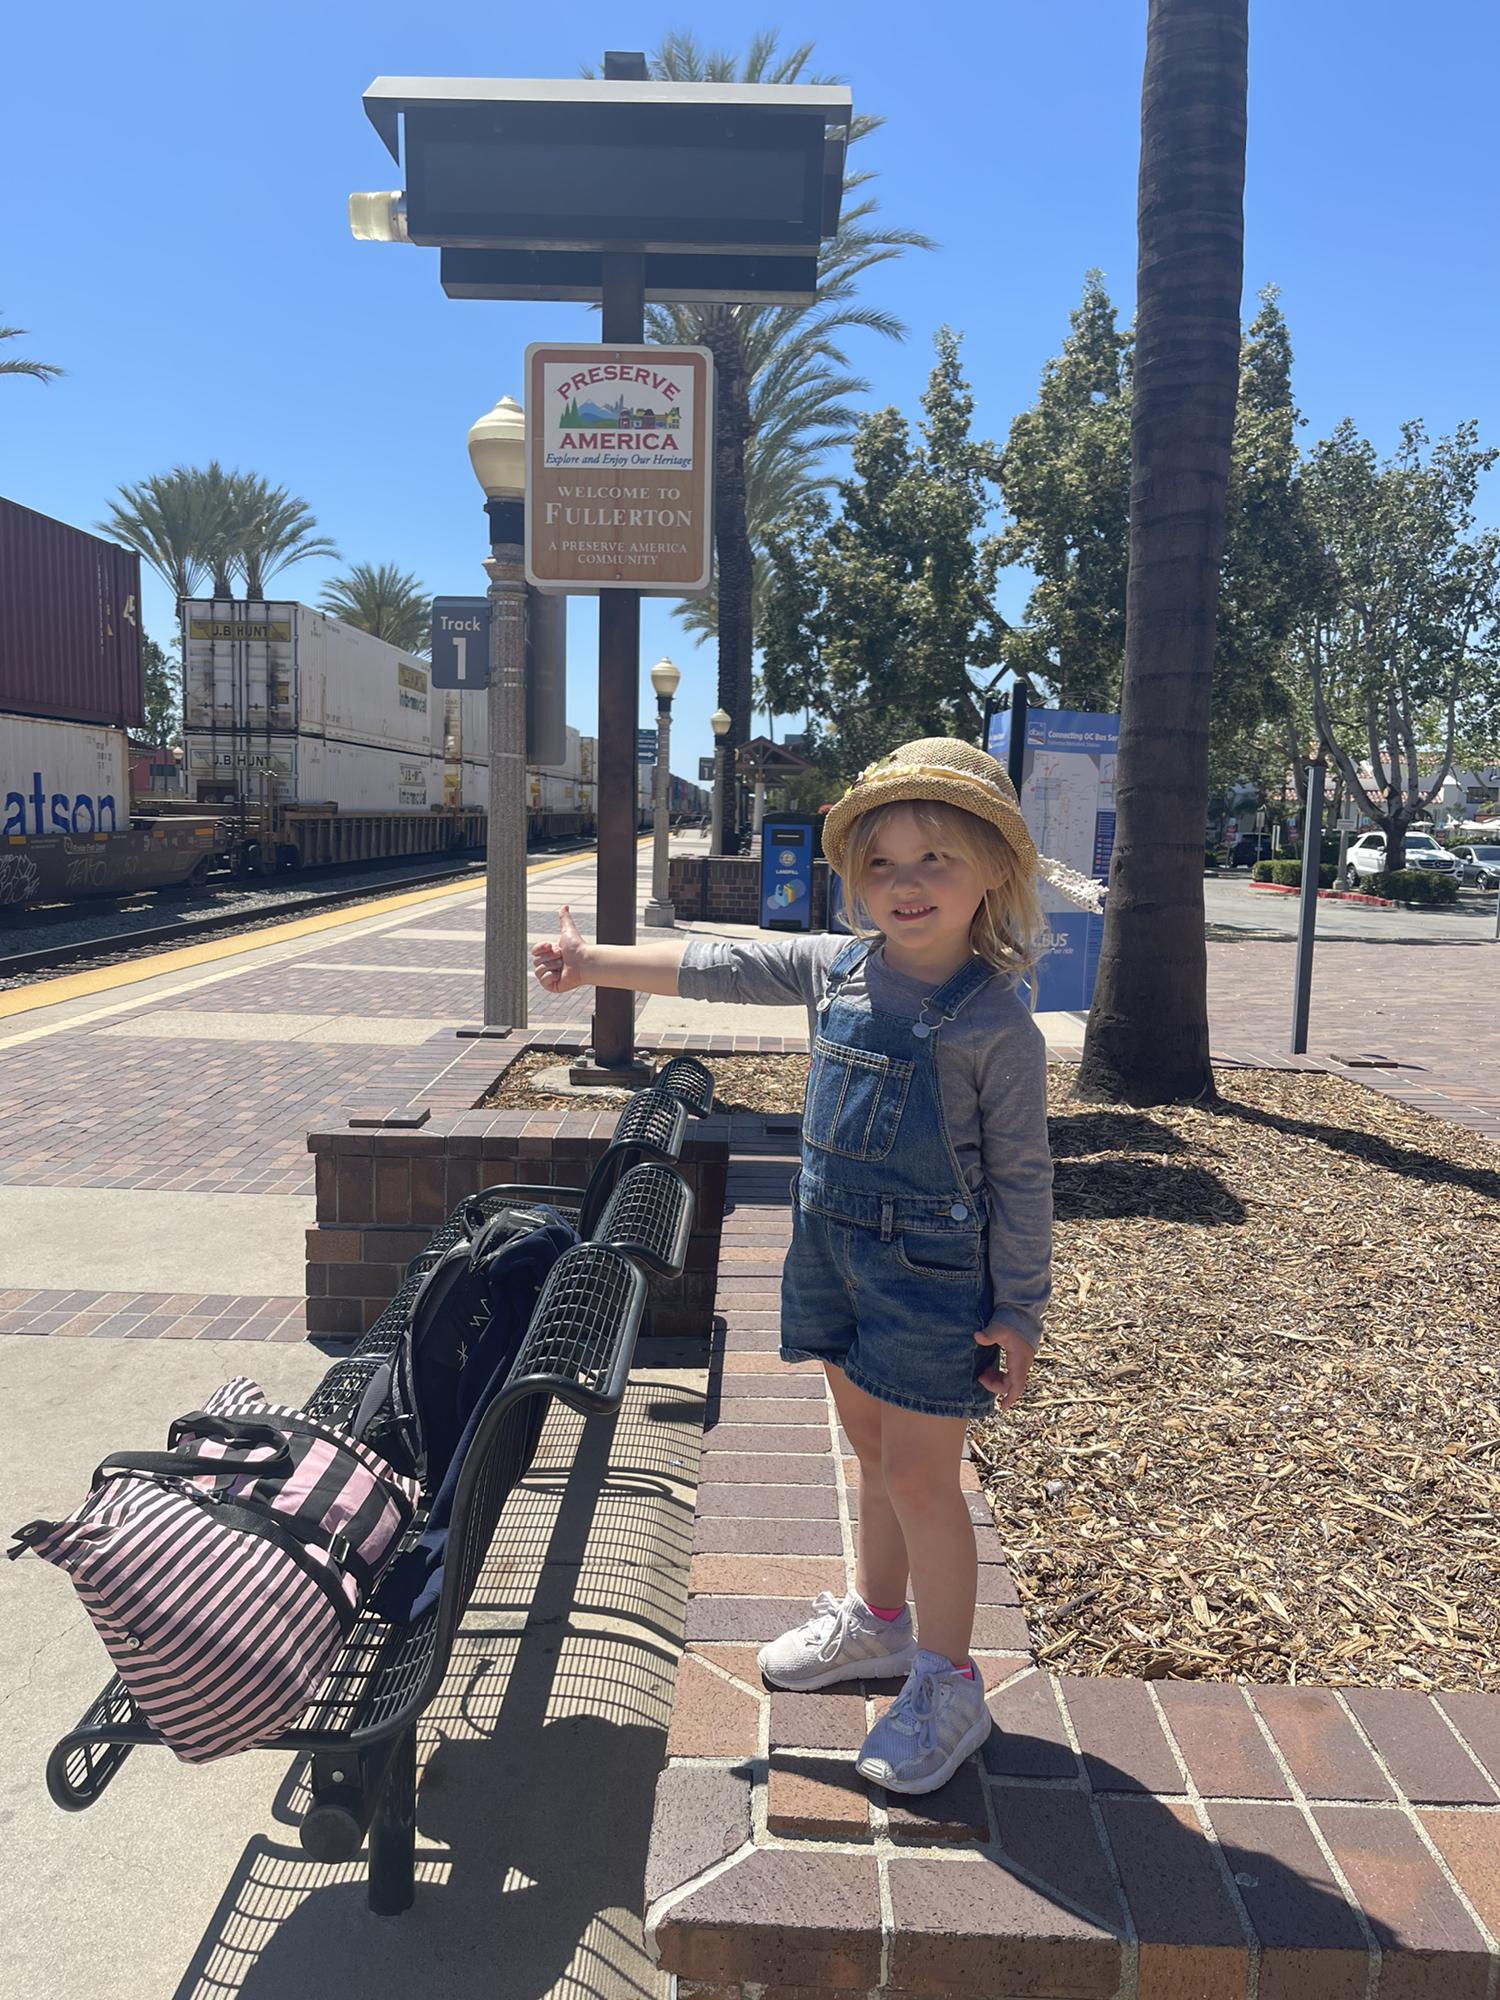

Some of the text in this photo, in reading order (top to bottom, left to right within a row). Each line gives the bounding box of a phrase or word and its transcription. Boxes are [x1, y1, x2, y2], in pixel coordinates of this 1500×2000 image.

[557, 365, 681, 402] PRESERVE
[559, 432, 679, 450] AMERICA
[546, 453, 692, 468] Explore and Enjoy Our Heritage
[557, 486, 681, 500] WELCOME TO
[544, 502, 693, 528] FULLERTON
[548, 541, 687, 553] A PRESERVE AMERICA
[578, 553, 659, 565] COMMUNITY
[440, 616, 481, 631] Track
[237, 626, 268, 637] HUNT
[452, 637, 466, 680] 1
[237, 756, 271, 767] HUNT
[3, 772, 116, 835] atson
